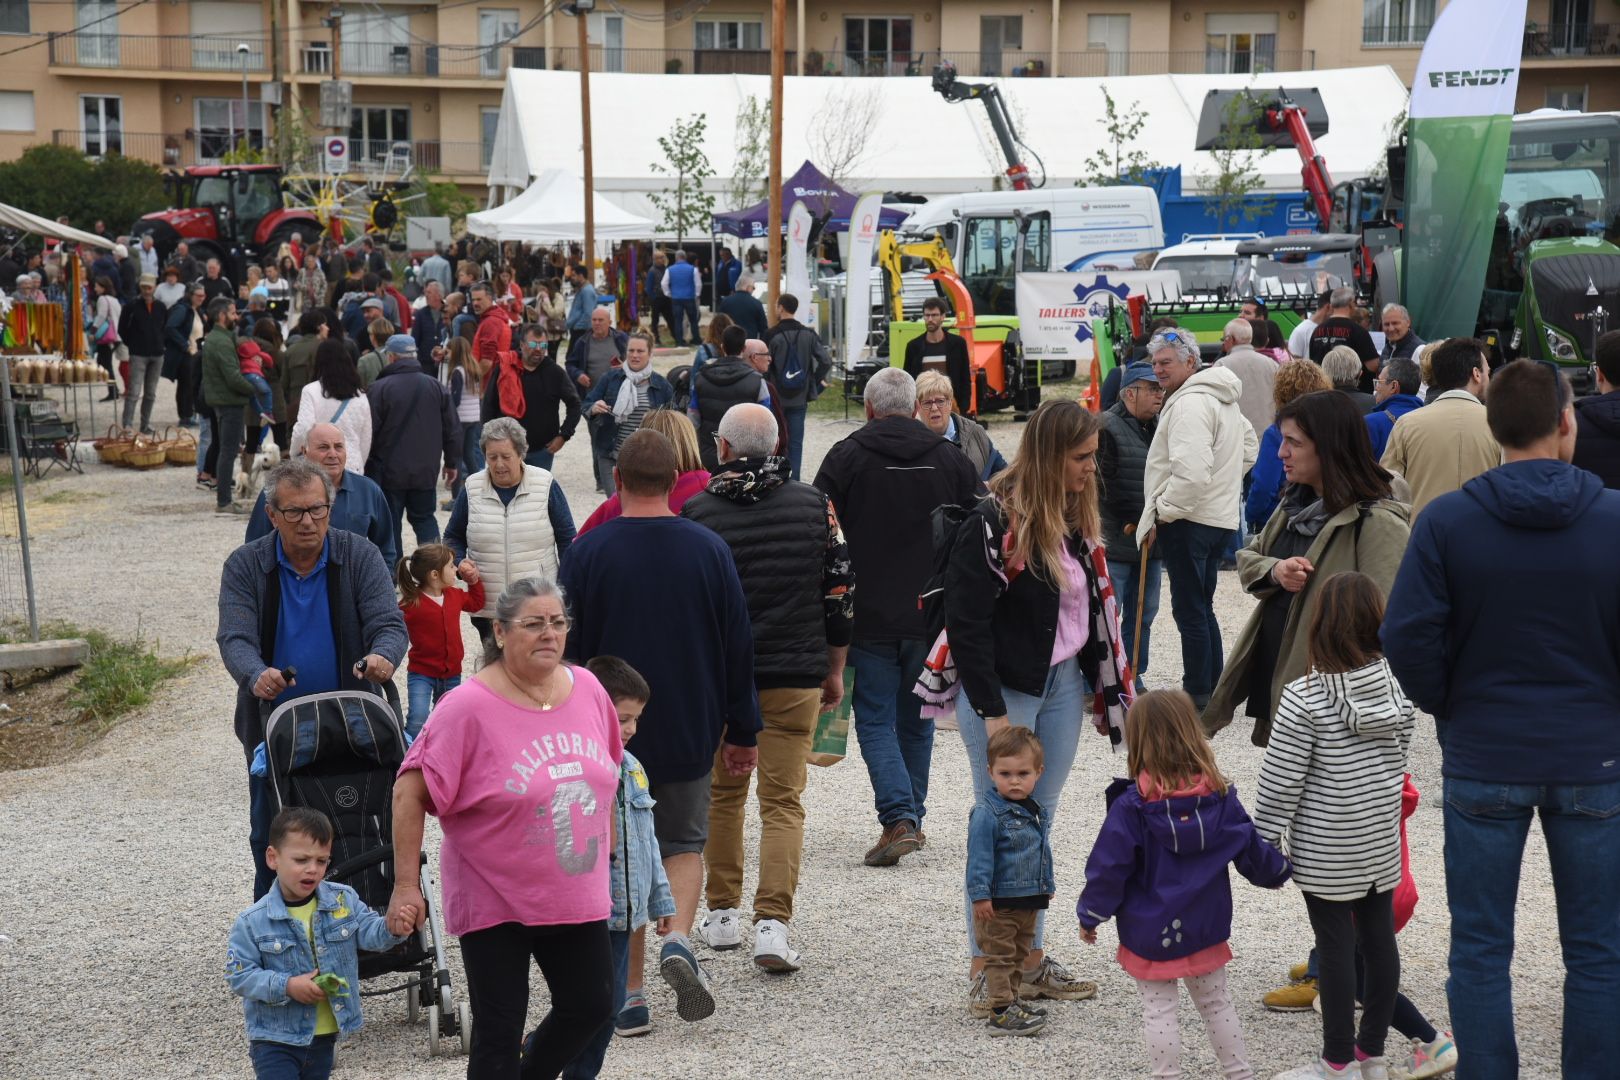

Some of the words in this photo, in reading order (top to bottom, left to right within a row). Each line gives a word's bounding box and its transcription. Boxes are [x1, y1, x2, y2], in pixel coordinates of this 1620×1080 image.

[1428, 68, 1515, 88] FENDT
[1039, 308, 1086, 318] TALLERS
[504, 732, 621, 795] CALIFORNIA
[552, 780, 598, 876] C
